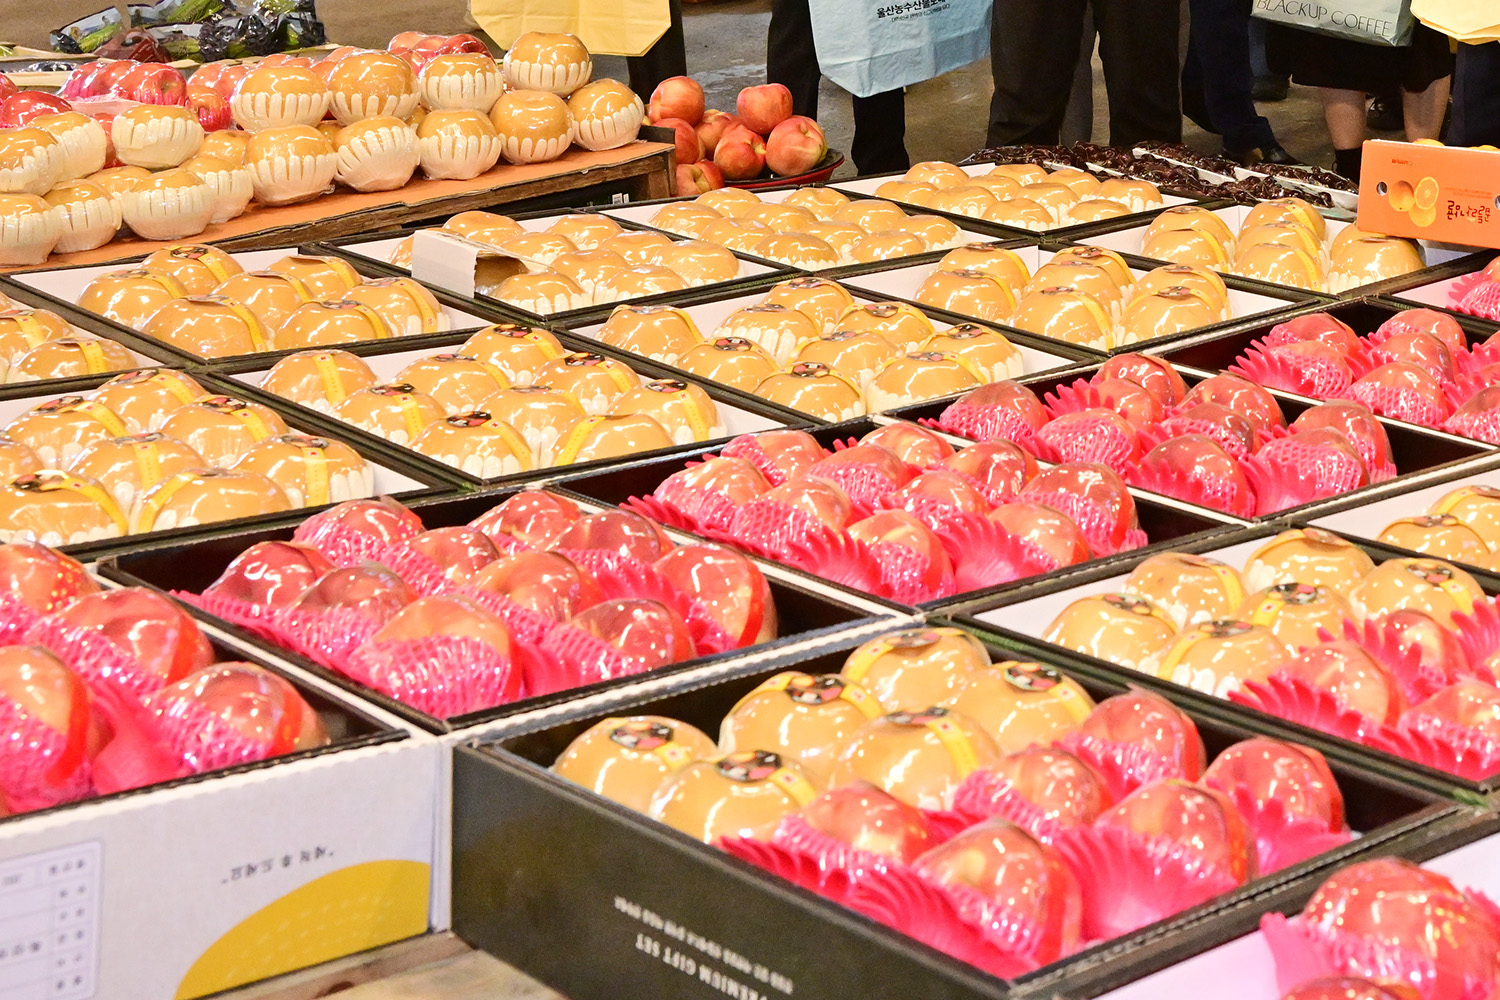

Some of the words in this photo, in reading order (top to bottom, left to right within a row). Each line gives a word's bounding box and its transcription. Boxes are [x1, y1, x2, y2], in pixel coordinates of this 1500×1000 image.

[1331, 10, 1393, 37] COFFEE
[635, 932, 661, 958] SET
[663, 946, 696, 977] GIFT
[699, 963, 768, 1000] REMIUM
